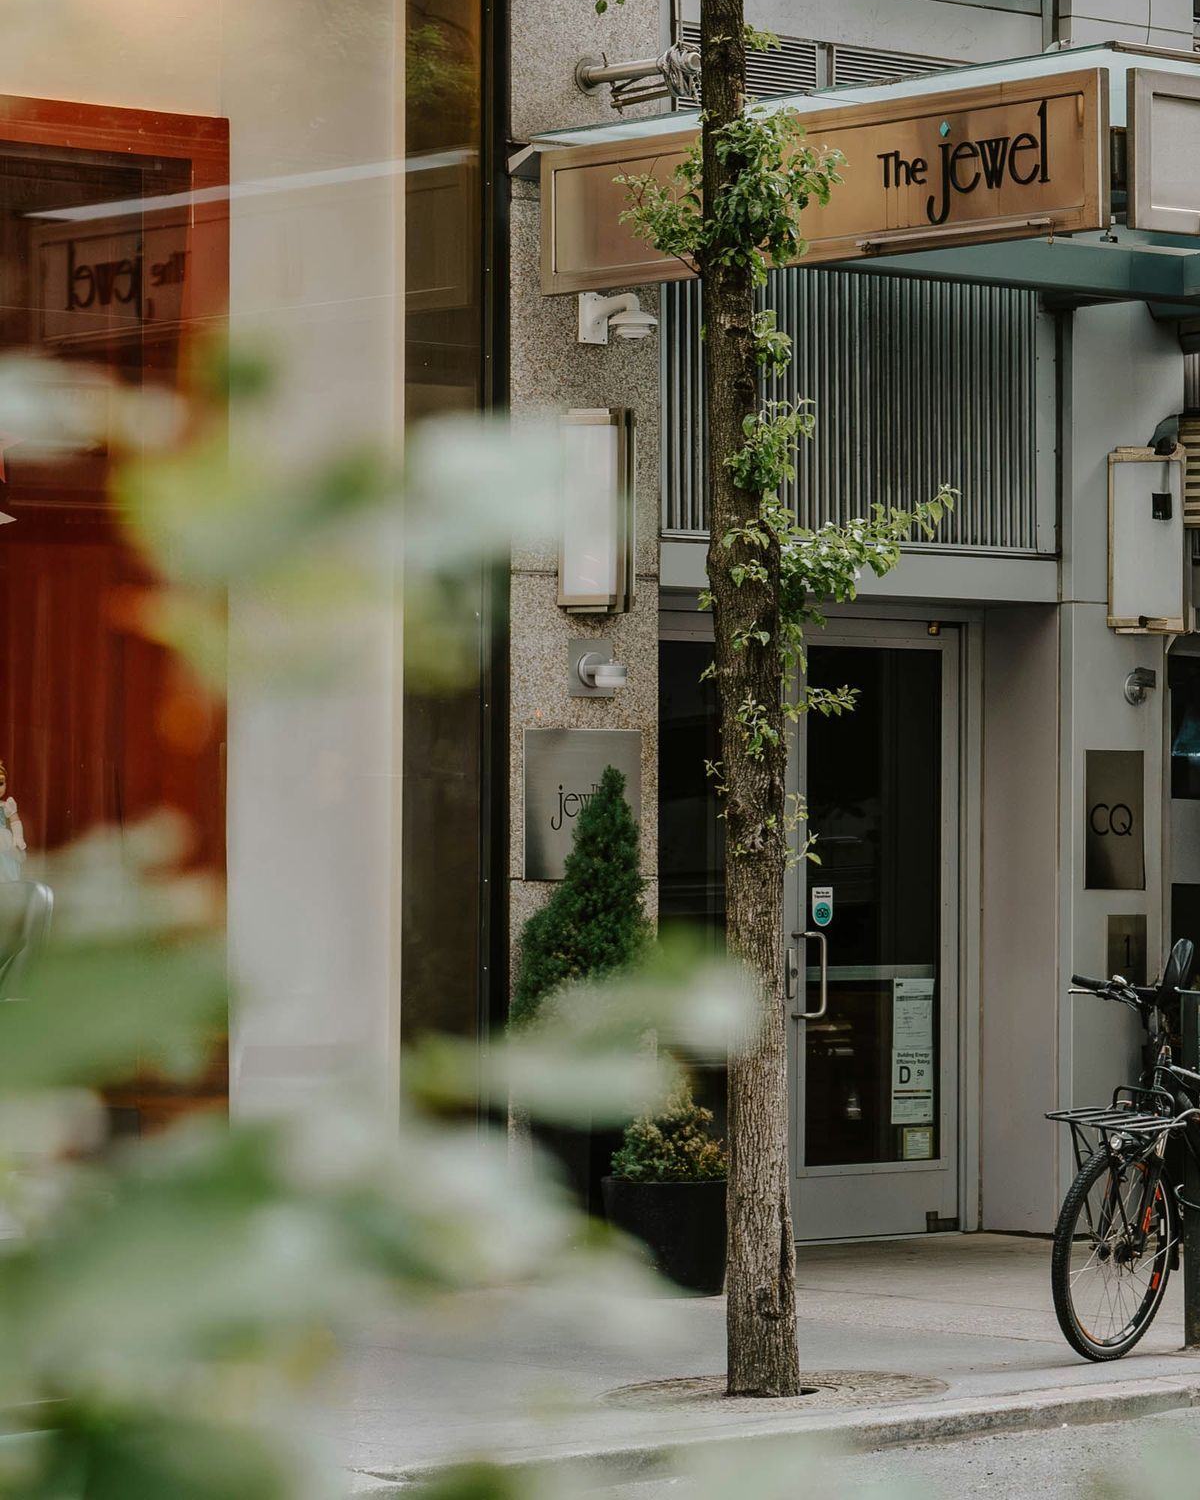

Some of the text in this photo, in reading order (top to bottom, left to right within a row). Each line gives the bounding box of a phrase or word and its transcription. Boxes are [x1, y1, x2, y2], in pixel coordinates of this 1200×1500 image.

[876, 98, 1051, 226] The jewel
[1089, 801, 1133, 837] CQ
[898, 1066, 925, 1085] D 50
